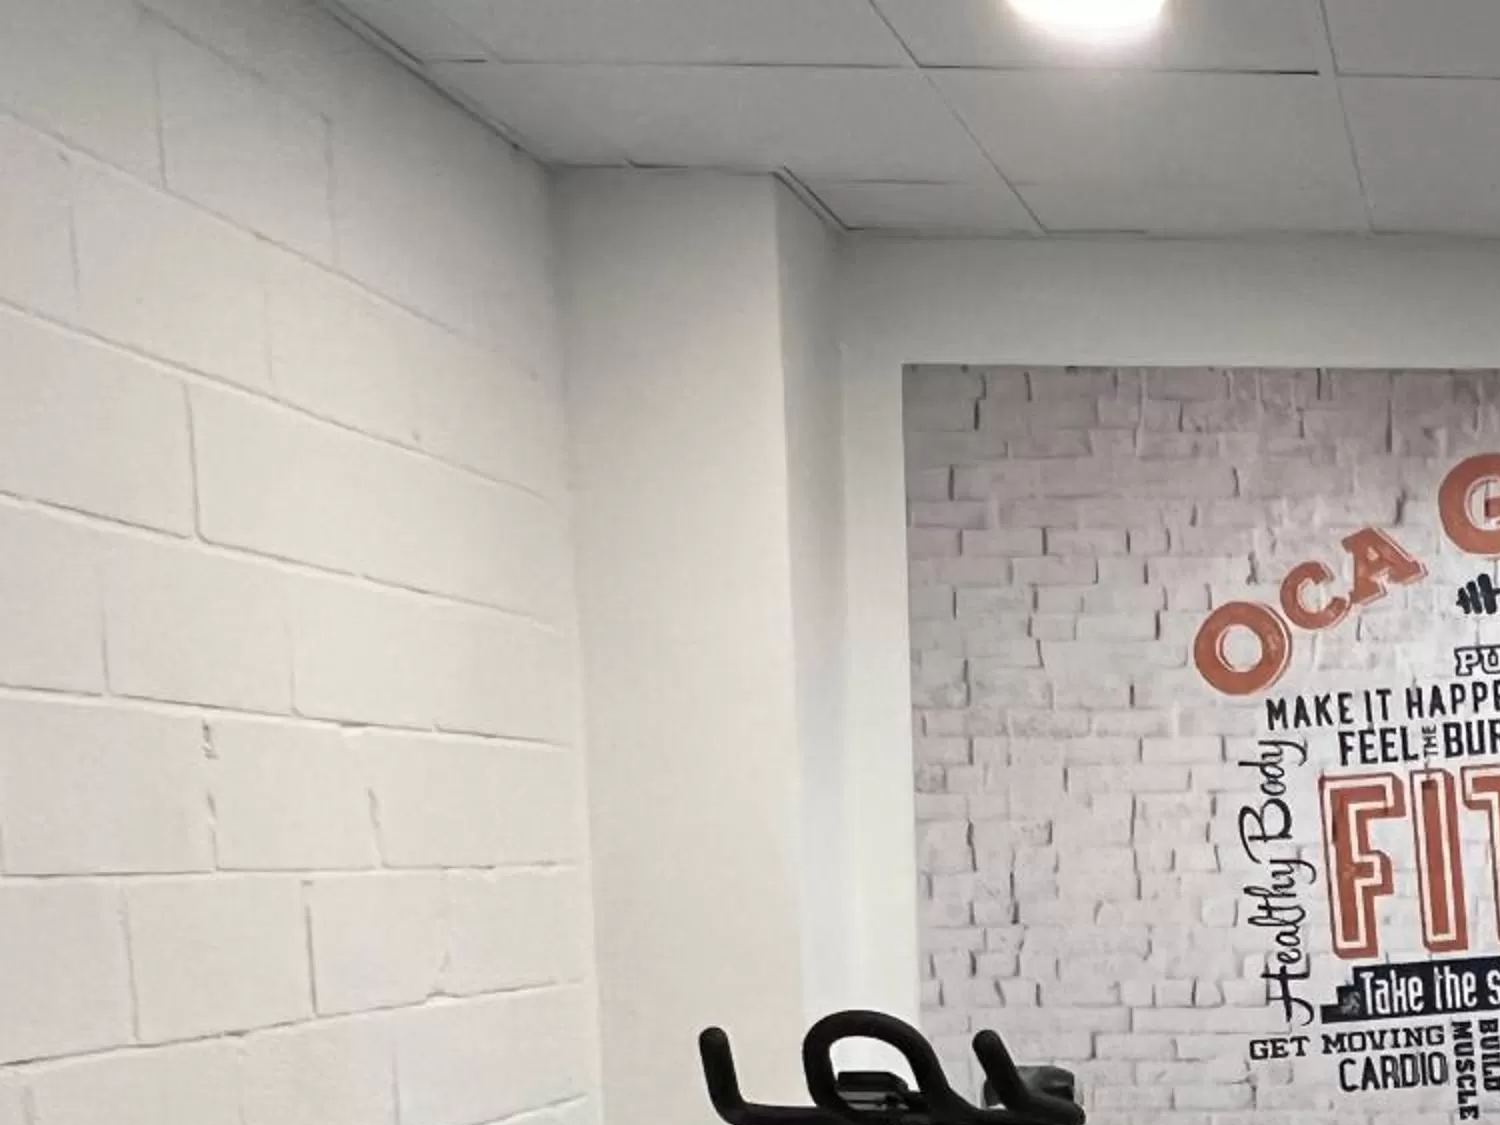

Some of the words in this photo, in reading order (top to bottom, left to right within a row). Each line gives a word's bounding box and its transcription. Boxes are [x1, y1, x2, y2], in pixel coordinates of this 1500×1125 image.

[1194, 527, 1429, 696] OCA
[1265, 692, 1354, 731] MAKE
[1364, 688, 1392, 723] IT
[1338, 726, 1419, 767] FEEL
[1421, 724, 1438, 758] THE
[1237, 739, 1309, 864] Body
[1243, 858, 1317, 1027] Healthy
[1359, 969, 1424, 1016] Take
[1433, 965, 1477, 1010] the
[1249, 1035, 1311, 1060] GET
[1321, 1025, 1445, 1054] MOVING
[1339, 1051, 1449, 1092] CARDIO
[1451, 1020, 1480, 1121] MUSCLE
